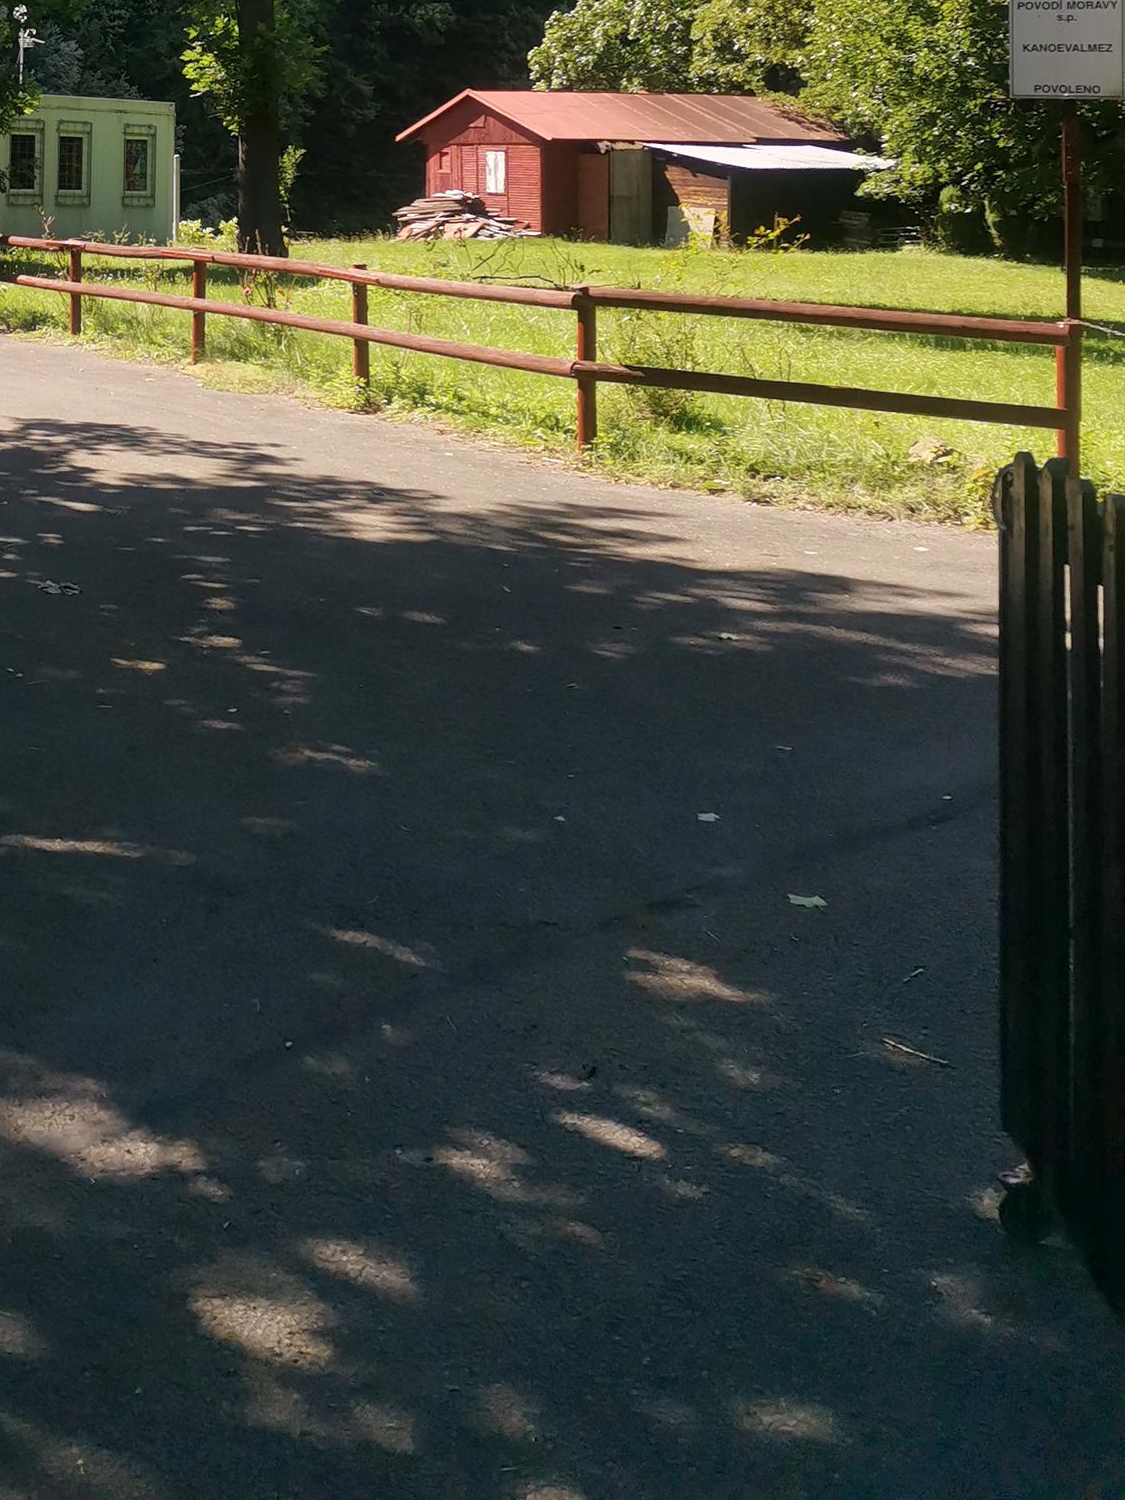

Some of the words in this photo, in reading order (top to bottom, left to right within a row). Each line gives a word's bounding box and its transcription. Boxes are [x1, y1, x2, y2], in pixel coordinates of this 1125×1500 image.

[1066, 0, 1118, 10] MORAVY
[1056, 14, 1078, 23] s.p.
[1022, 43, 1113, 53] KANOEVALMEZ
[1034, 84, 1101, 94] POVOLENO
